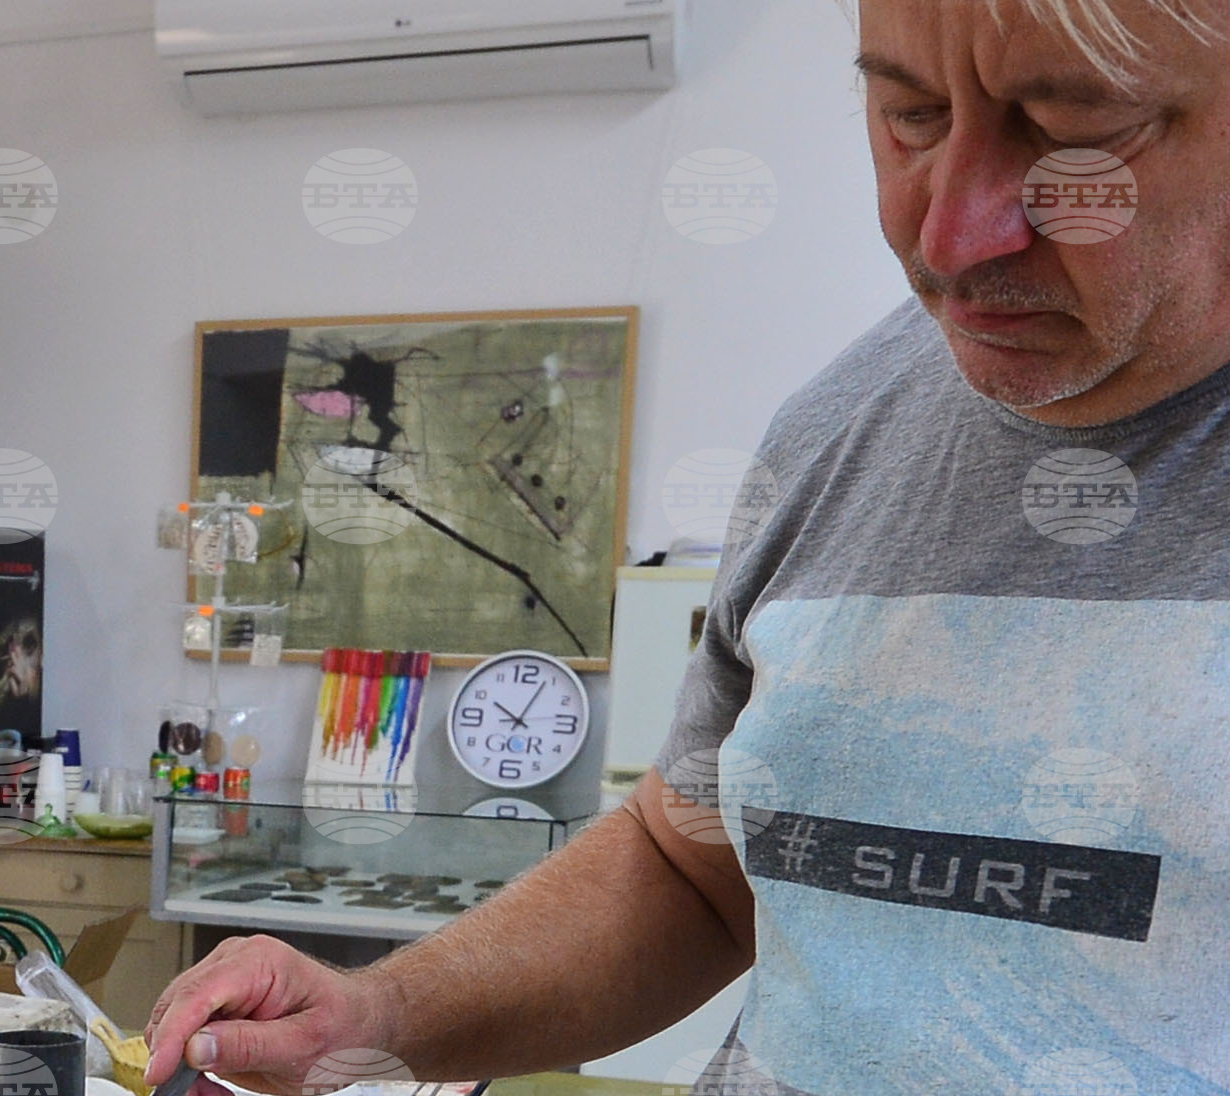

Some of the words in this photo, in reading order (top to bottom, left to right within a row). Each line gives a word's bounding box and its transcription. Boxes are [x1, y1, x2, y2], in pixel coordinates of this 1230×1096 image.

[496, 673, 505, 683] 11
[514, 665, 539, 684] 12
[475, 690, 487, 700] 10
[561, 696, 570, 706] 2
[460, 707, 484, 727] 9
[552, 714, 578, 734] 3
[467, 736, 476, 747] 8
[552, 744, 561, 753] 4
[481, 757, 490, 767] 7
[532, 761, 540, 771] 5
[498, 759, 522, 779] 6
[852, 845, 1091, 914] SURF
